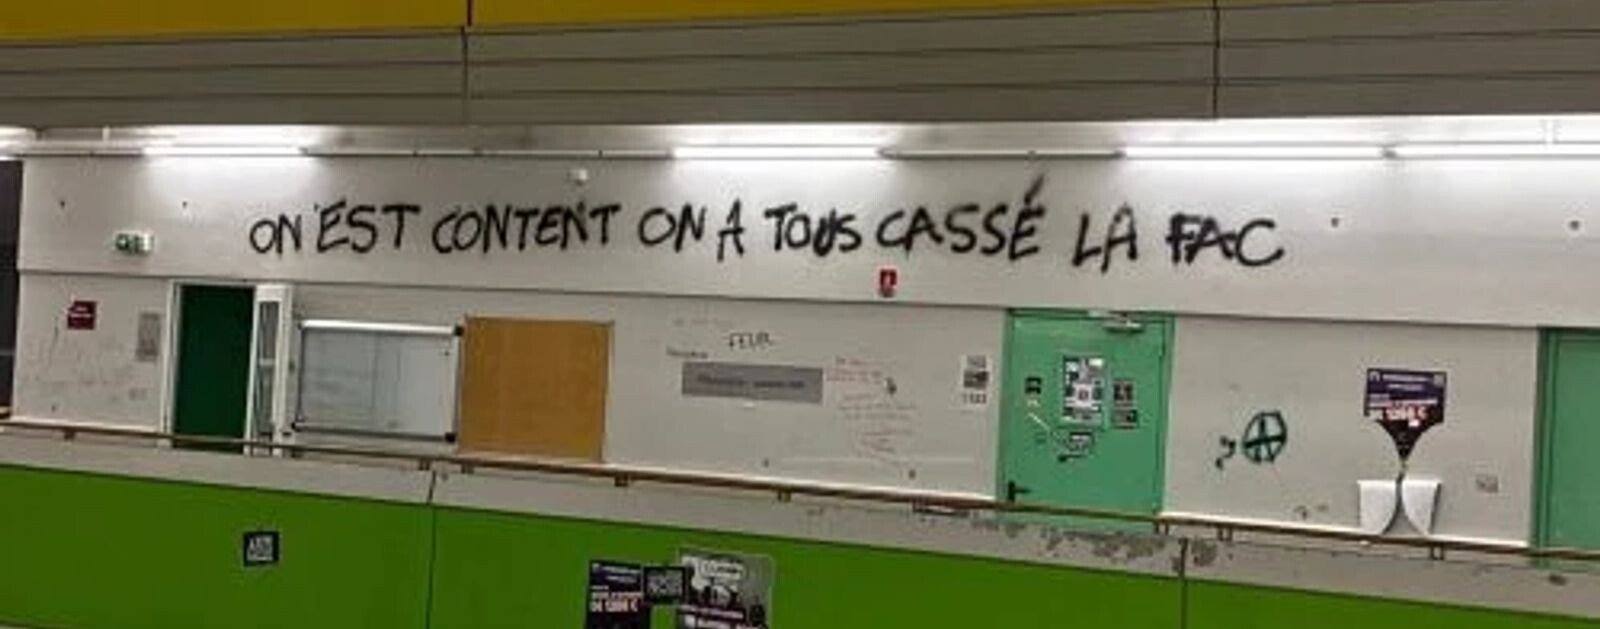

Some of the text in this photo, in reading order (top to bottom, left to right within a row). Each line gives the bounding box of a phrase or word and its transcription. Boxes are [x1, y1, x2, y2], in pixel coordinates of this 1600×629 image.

[250, 174, 1284, 273] ON EST CONTENT ON A TOUS CASSÉ LA FAC
